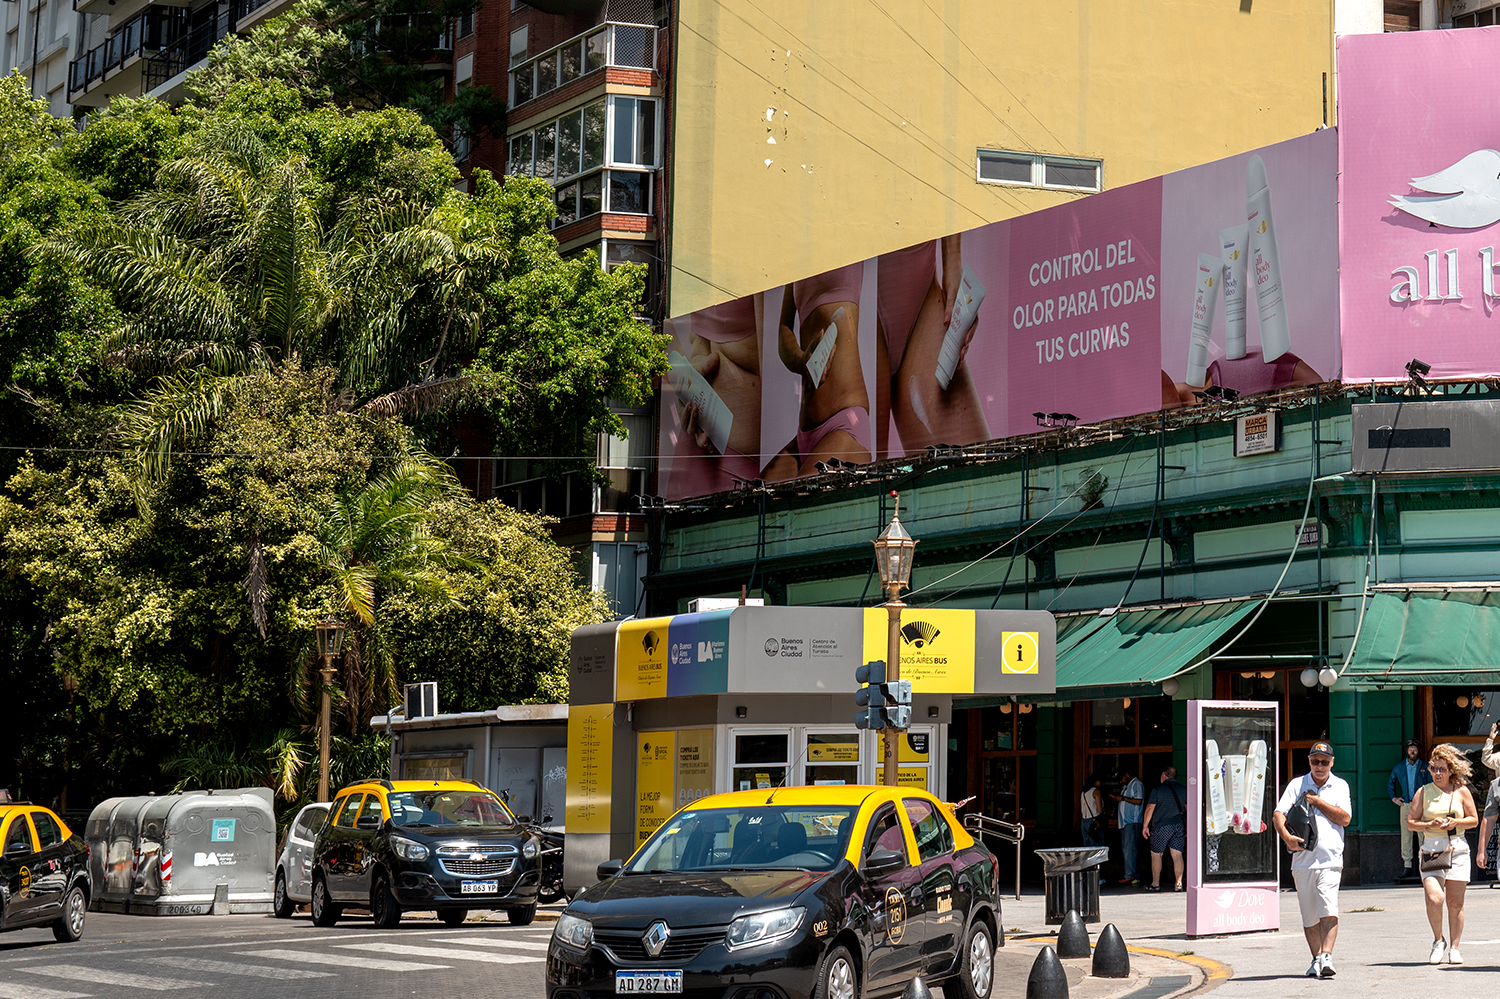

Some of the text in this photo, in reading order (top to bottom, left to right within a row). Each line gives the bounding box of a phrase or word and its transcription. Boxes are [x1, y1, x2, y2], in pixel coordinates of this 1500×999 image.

[1028, 238, 1136, 288] CONTROL DEL
[1388, 247, 1464, 305] all
[1012, 273, 1157, 331] OLOR PARA TODAS
[1036, 321, 1130, 365] TUS CURVAS
[1245, 416, 1267, 426] MARCA
[934, 657, 948, 665] BUS
[640, 791, 661, 801] LA MEJOR
[640, 805, 654, 814] FORMA
[640, 818, 646, 827] DE
[193, 852, 220, 867] BA
[1238, 889, 1266, 908] Dove
[813, 919, 828, 933] 002
[1213, 911, 1265, 928] all body deo
[619, 978, 634, 991] AD
[638, 978, 660, 991] 287
